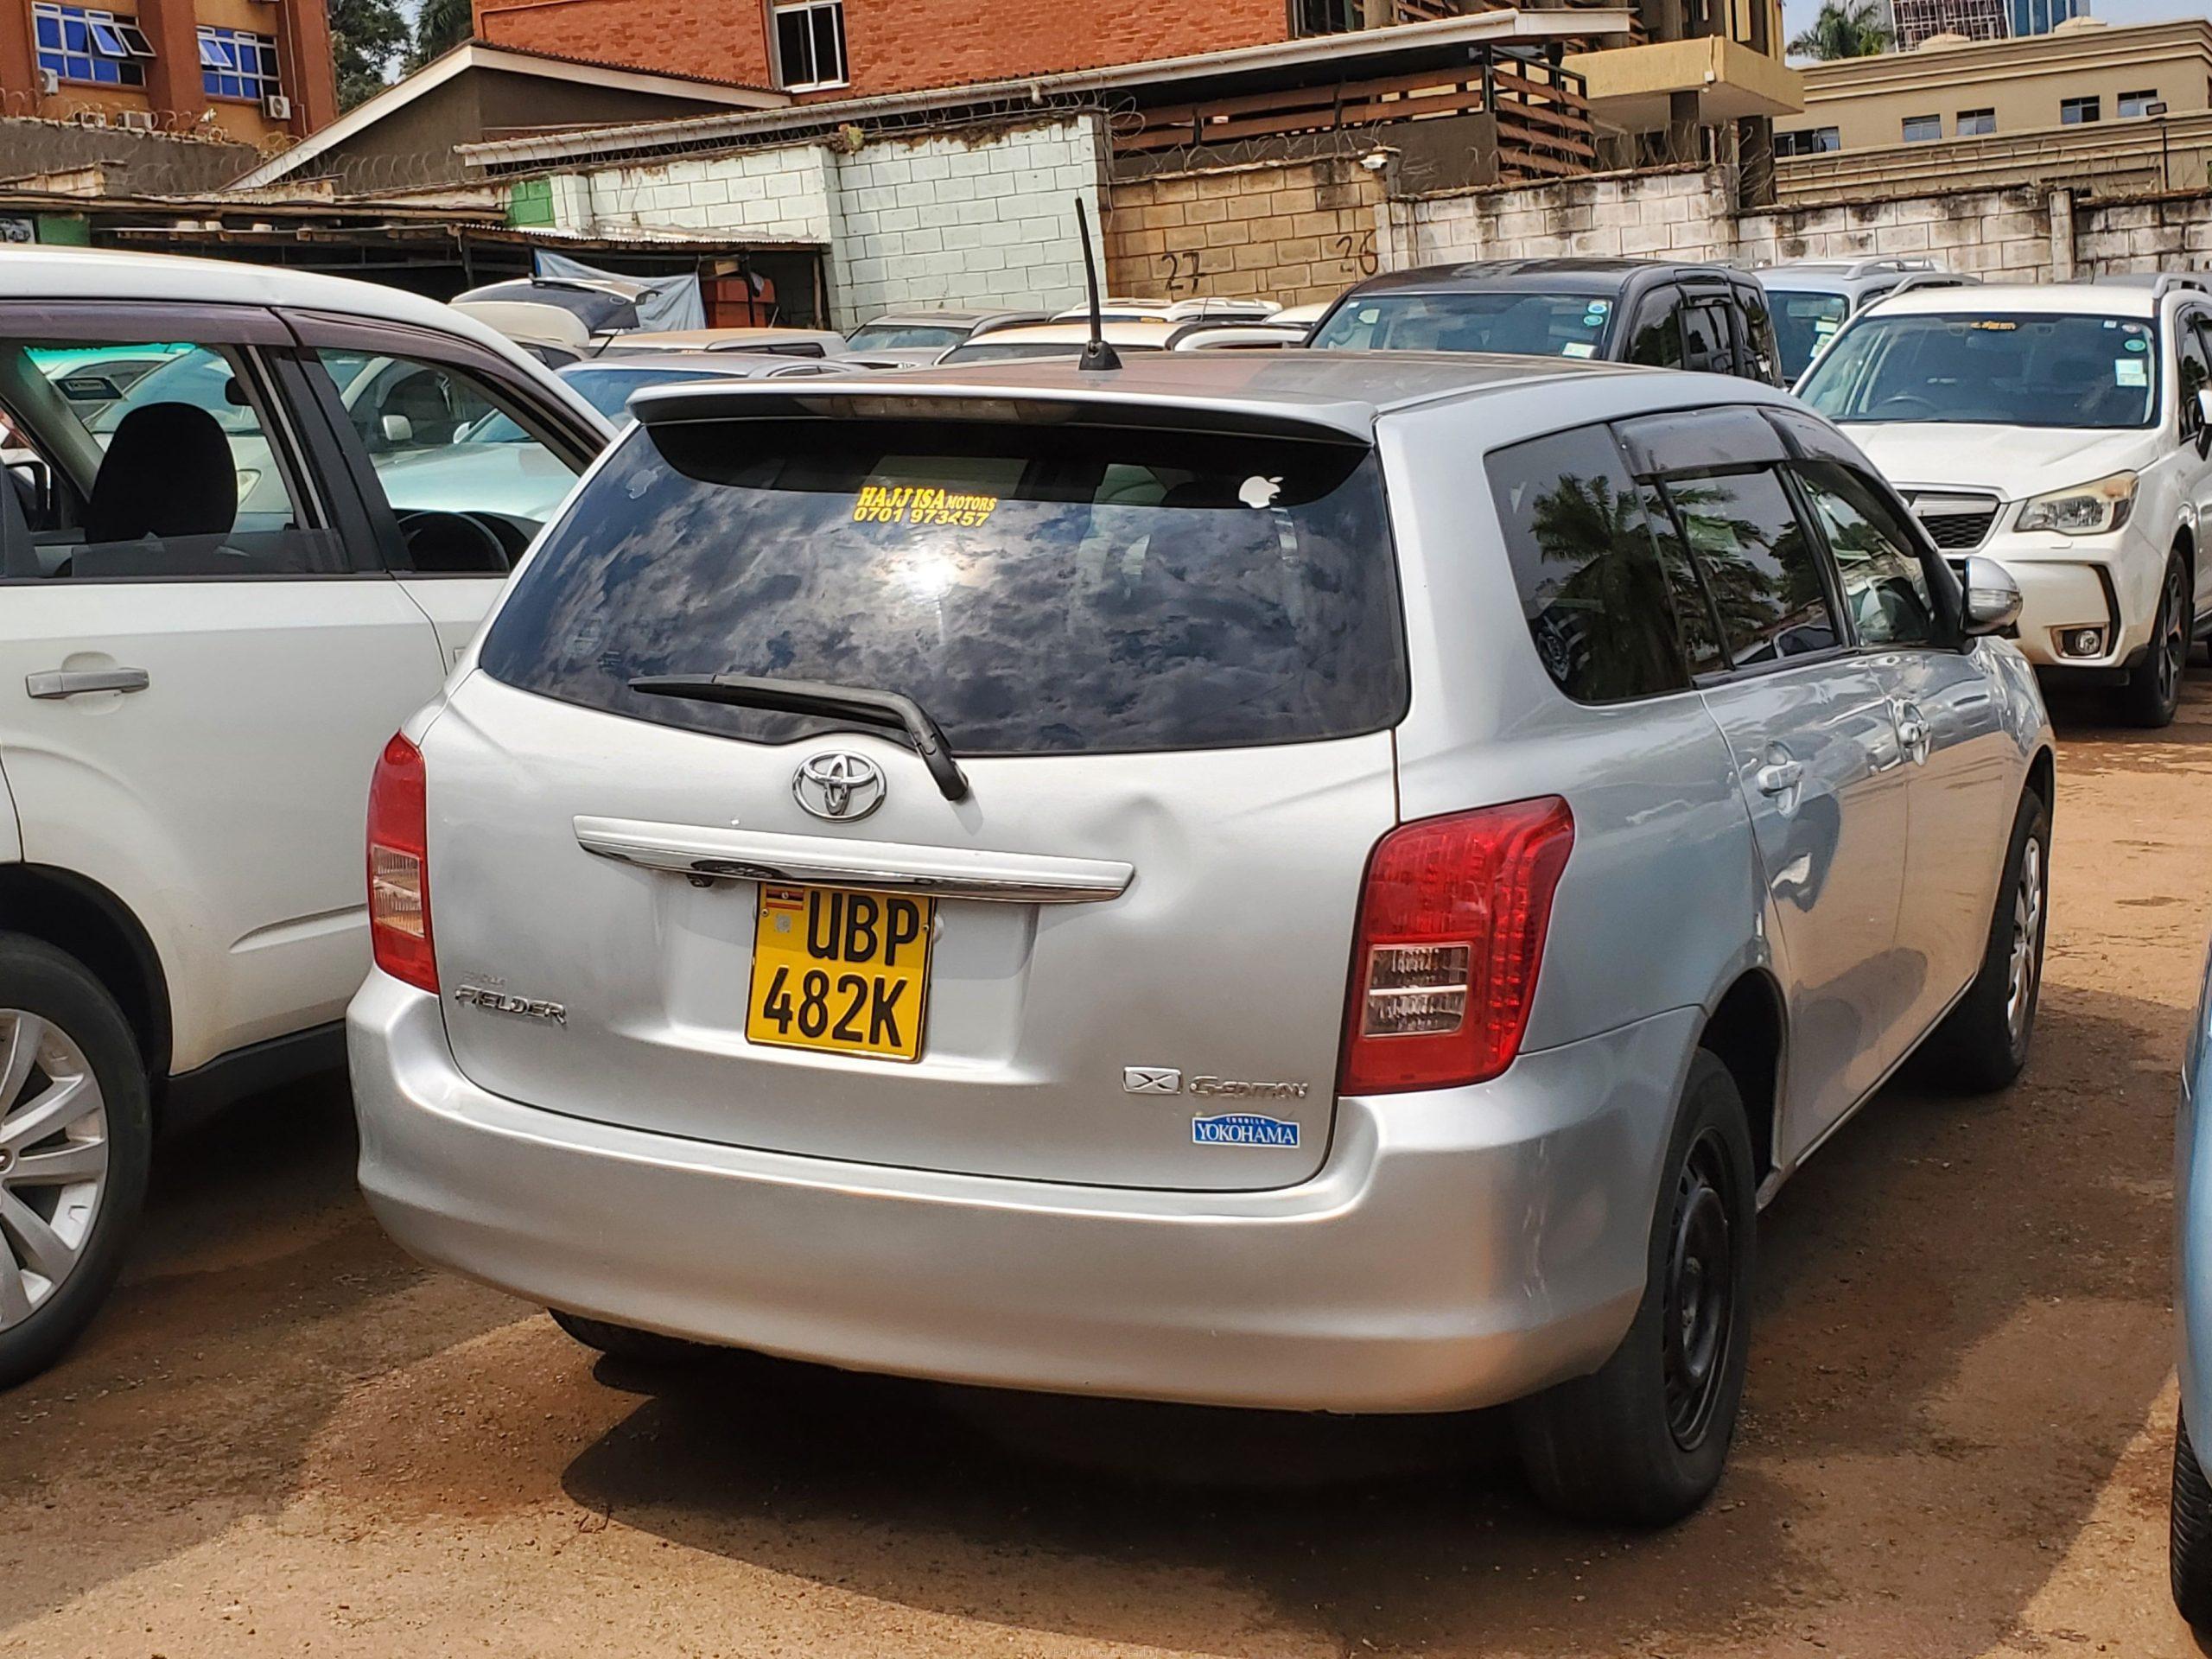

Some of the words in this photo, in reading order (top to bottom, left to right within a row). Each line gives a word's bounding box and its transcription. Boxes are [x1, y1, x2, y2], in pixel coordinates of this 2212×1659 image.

[1161, 251, 1205, 294] 27
[1335, 229, 1379, 276] 26
[853, 506, 905, 524] 0701
[909, 508, 991, 528] 973457
[856, 486, 914, 508] HAJJ
[910, 488, 945, 509] ISA
[945, 495, 998, 512] MOTORS
[806, 890, 920, 967] UBP
[455, 983, 568, 1026] FIELDER
[762, 966, 910, 1048] 482K
[1196, 1122, 1297, 1145] YOKOHAMA
